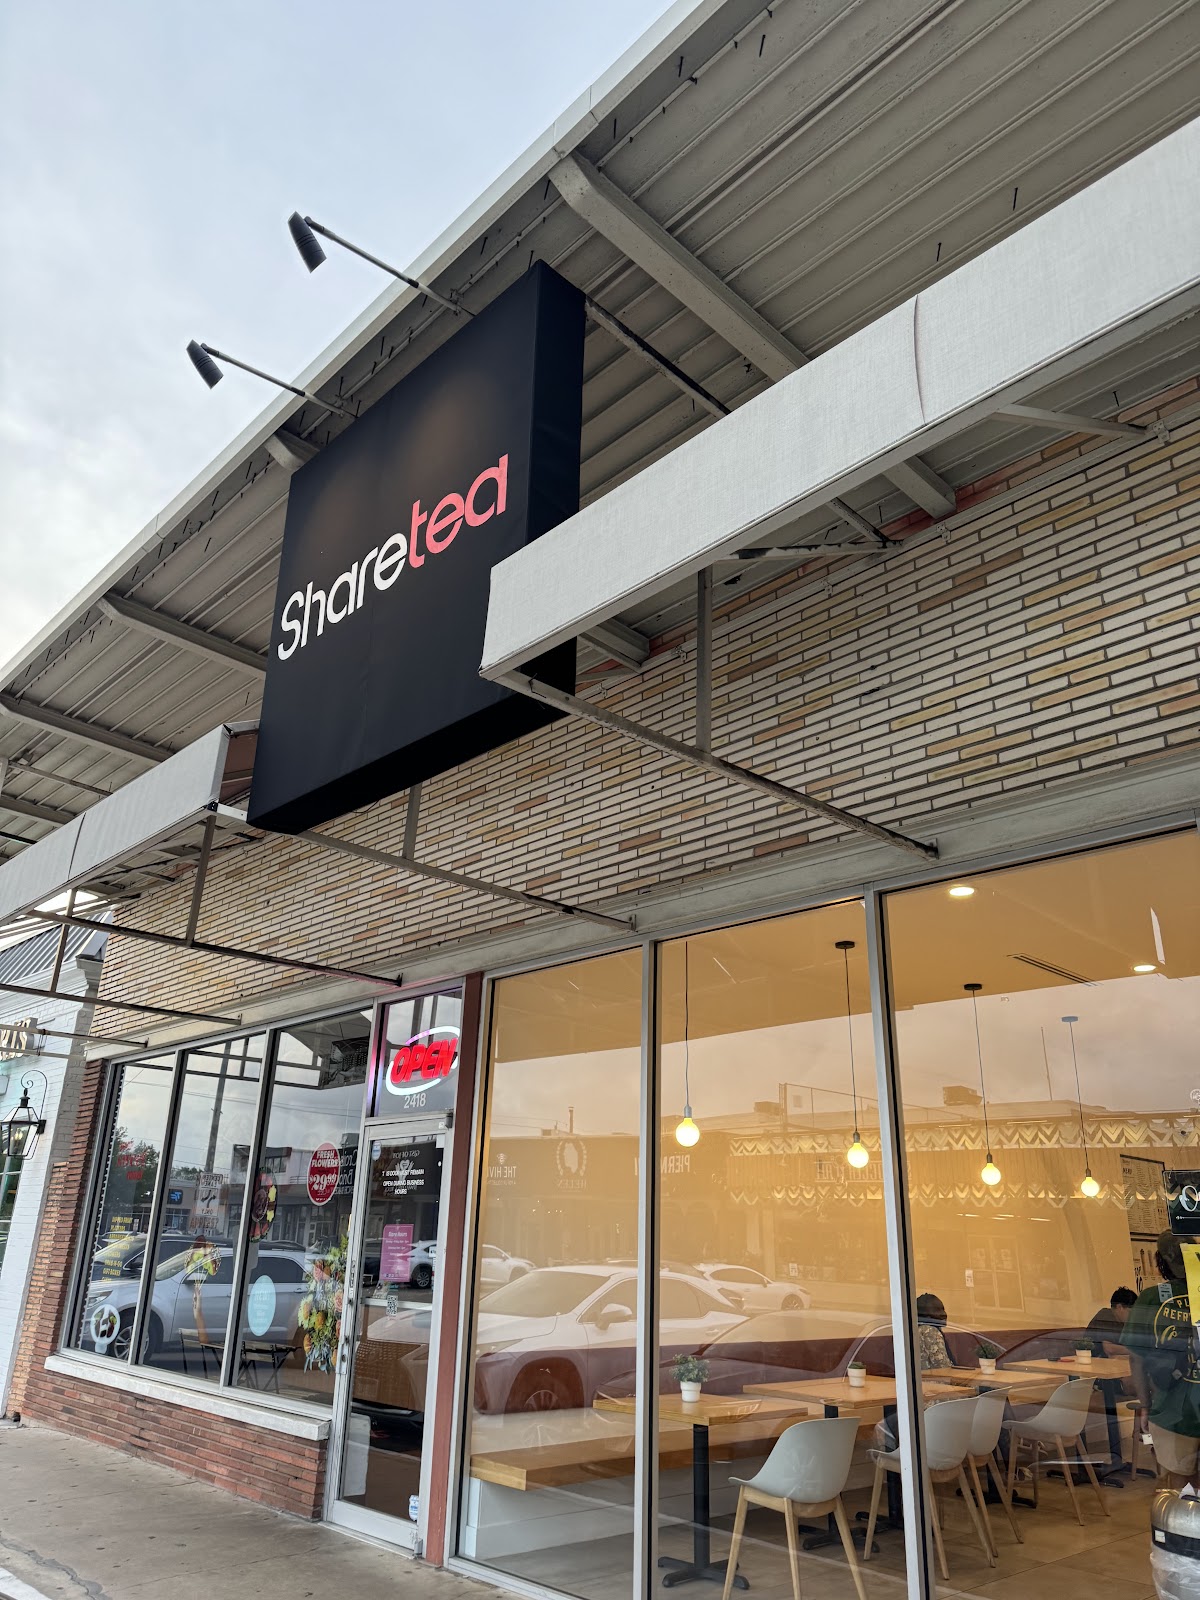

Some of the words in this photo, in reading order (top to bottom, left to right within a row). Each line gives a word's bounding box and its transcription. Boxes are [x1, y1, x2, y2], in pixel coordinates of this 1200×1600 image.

[277, 453, 509, 661] Sharetea
[390, 1037, 459, 1084] OPEN
[403, 1092, 427, 1109] 2418
[316, 1150, 335, 1159] FRESH
[311, 1159, 339, 1168] FLOWERS
[1163, 1307, 1191, 1323] REFR
